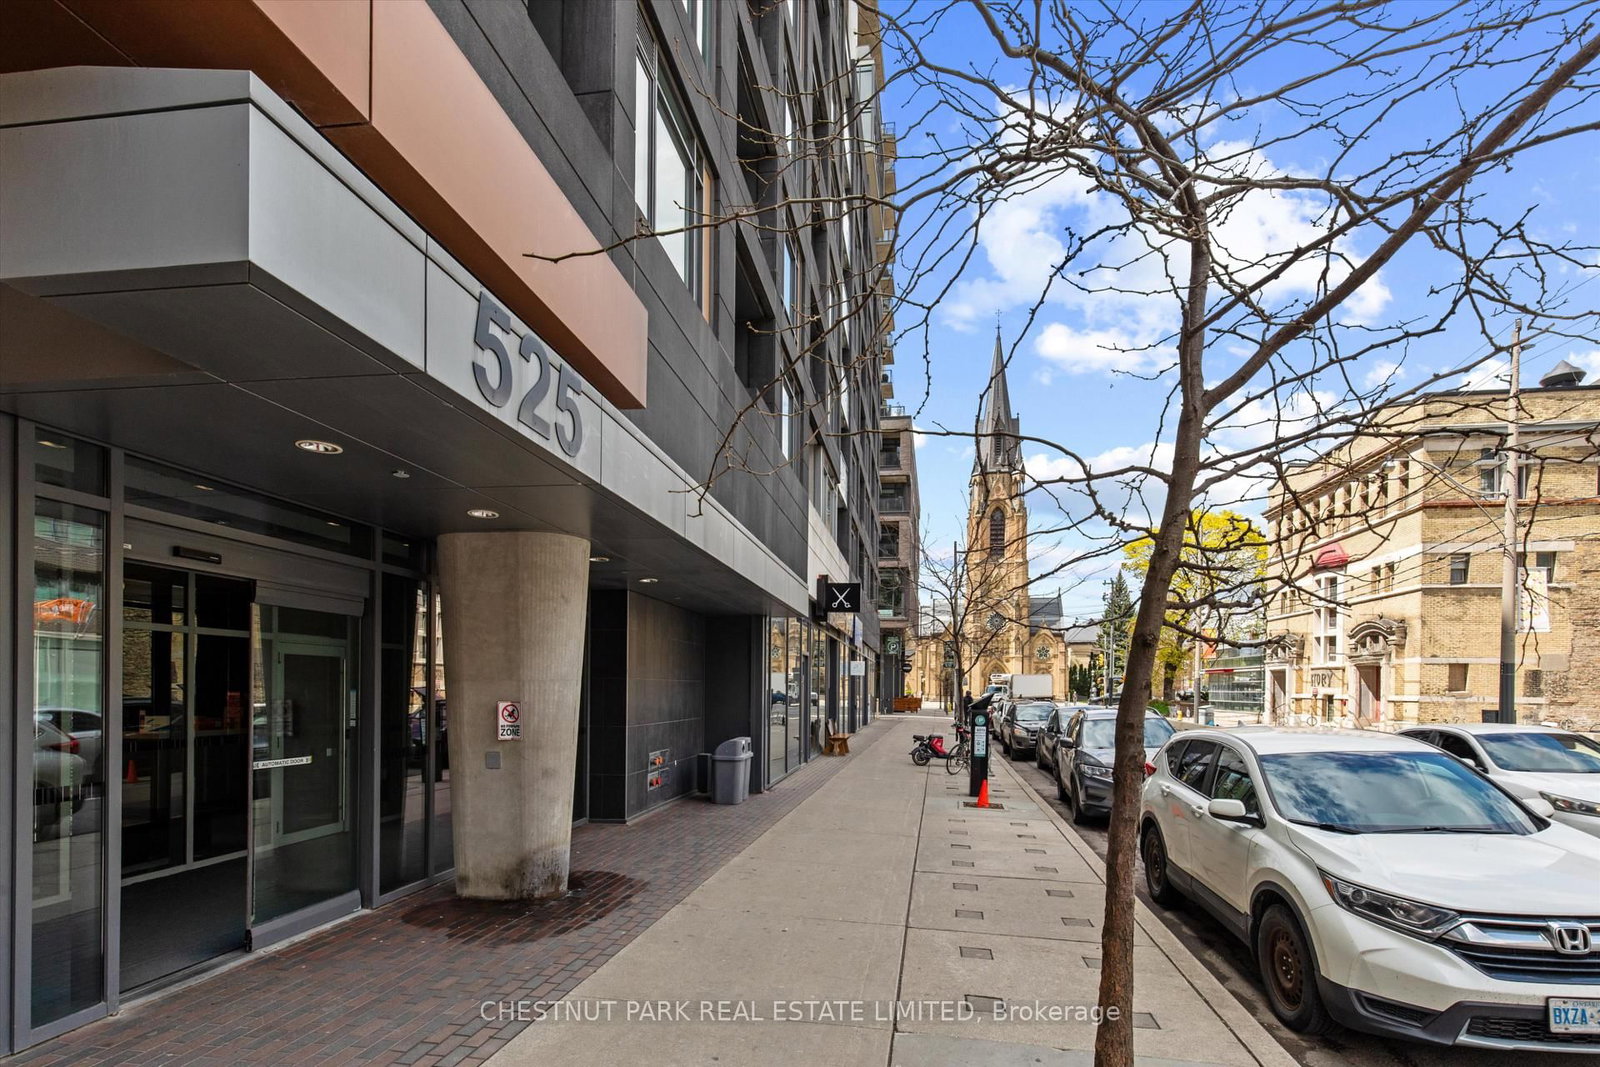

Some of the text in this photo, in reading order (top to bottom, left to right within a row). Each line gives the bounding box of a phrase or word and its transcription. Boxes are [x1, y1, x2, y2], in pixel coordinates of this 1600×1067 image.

[472, 291, 583, 457] 525
[500, 728, 520, 737] ZONE
[261, 759, 289, 767] AUTOMATIC
